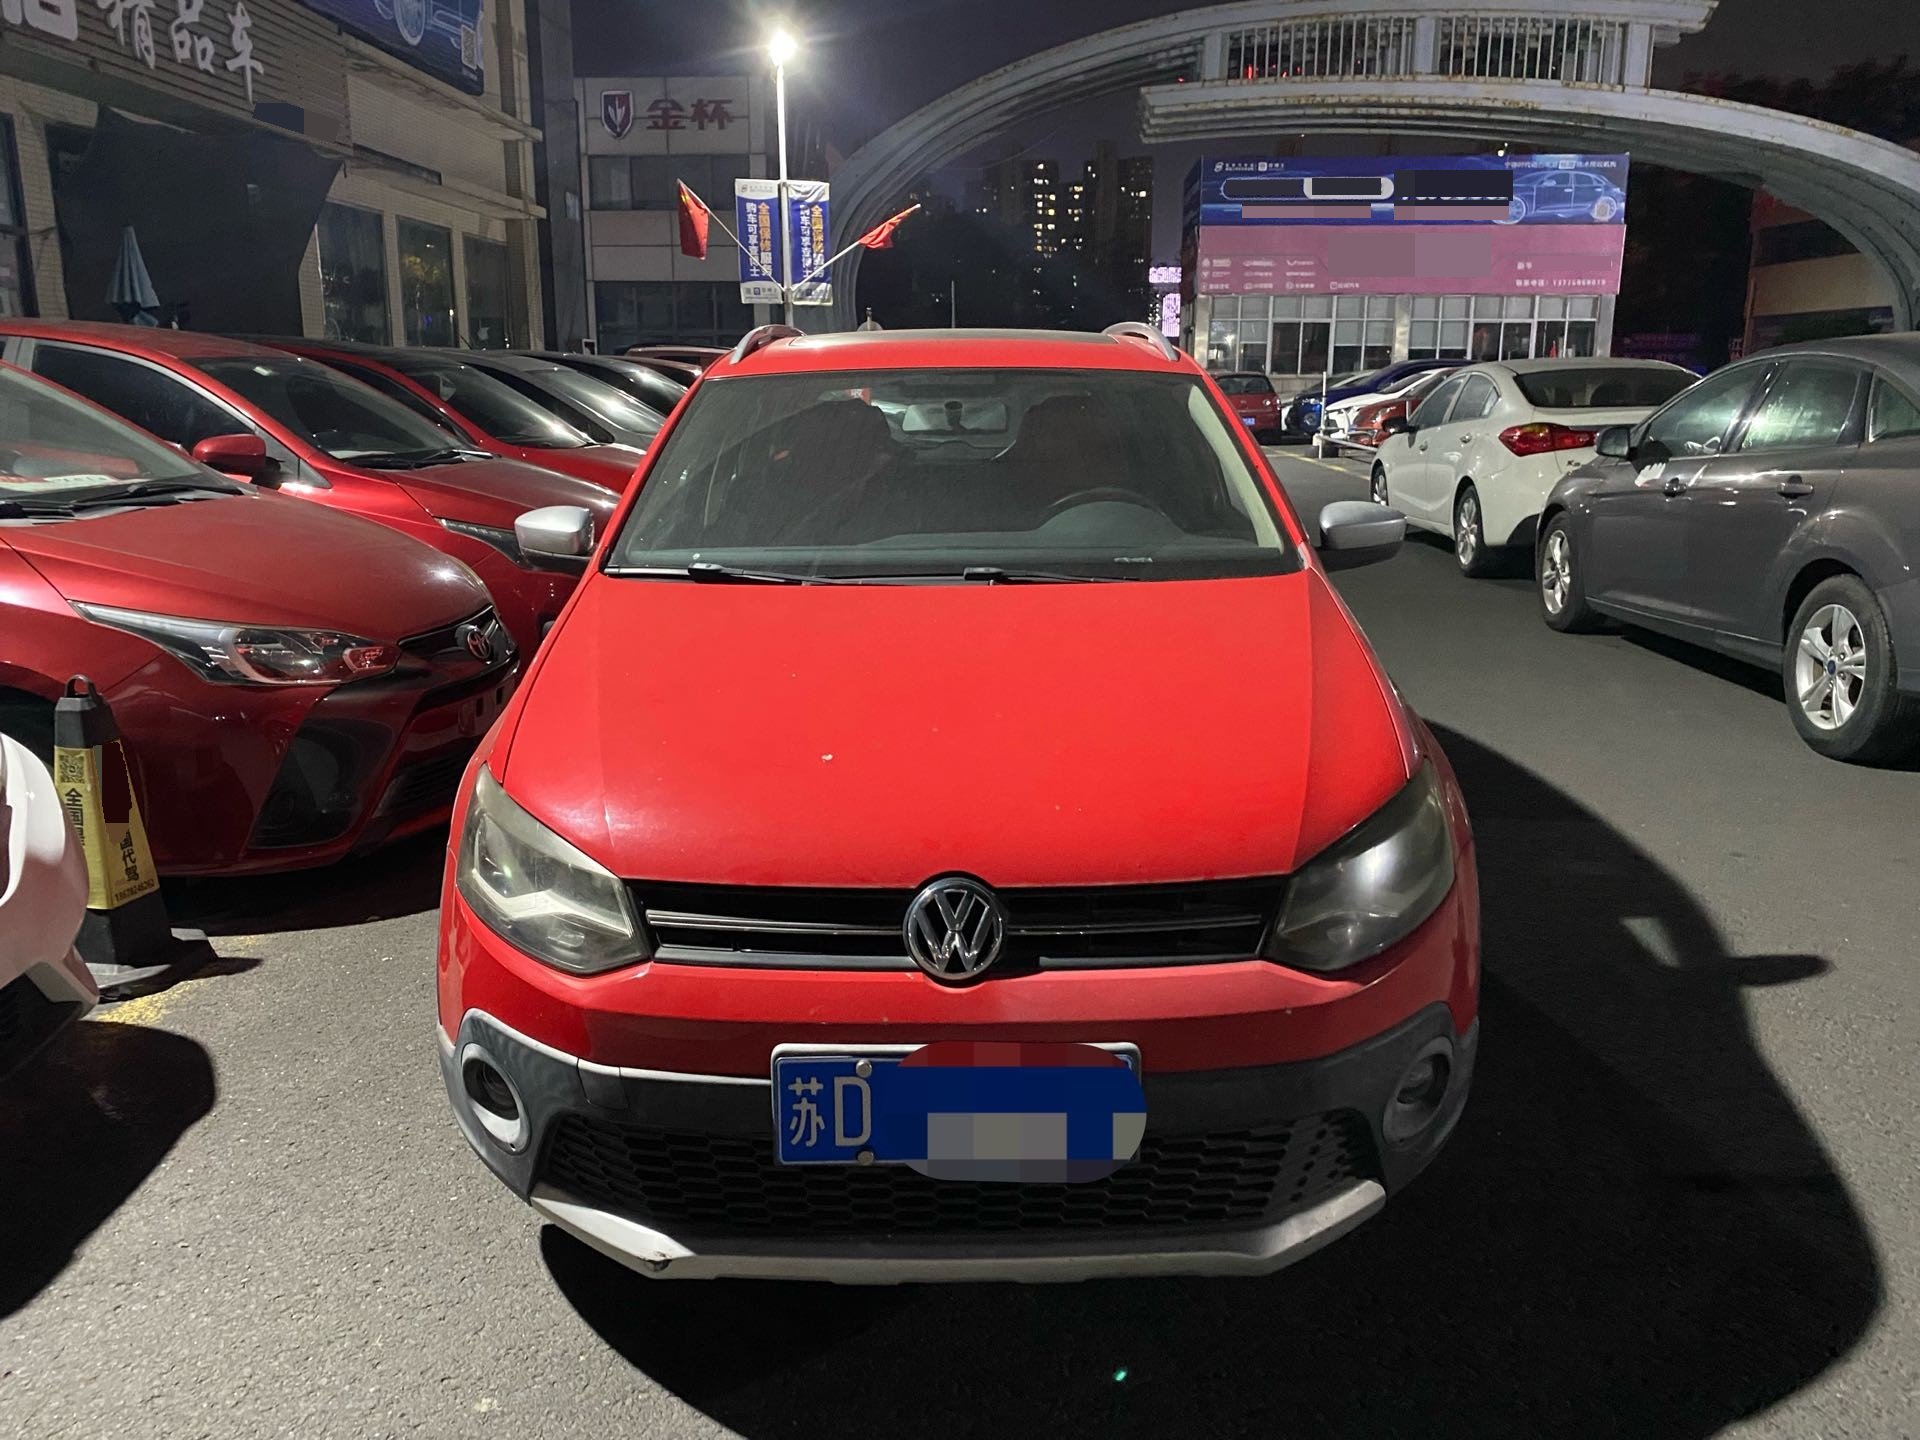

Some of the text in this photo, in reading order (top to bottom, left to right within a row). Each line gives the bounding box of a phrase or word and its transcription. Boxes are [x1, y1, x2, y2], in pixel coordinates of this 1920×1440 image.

[646, 98, 734, 131] 金杯
[758, 202, 773, 277] 全国保修服务
